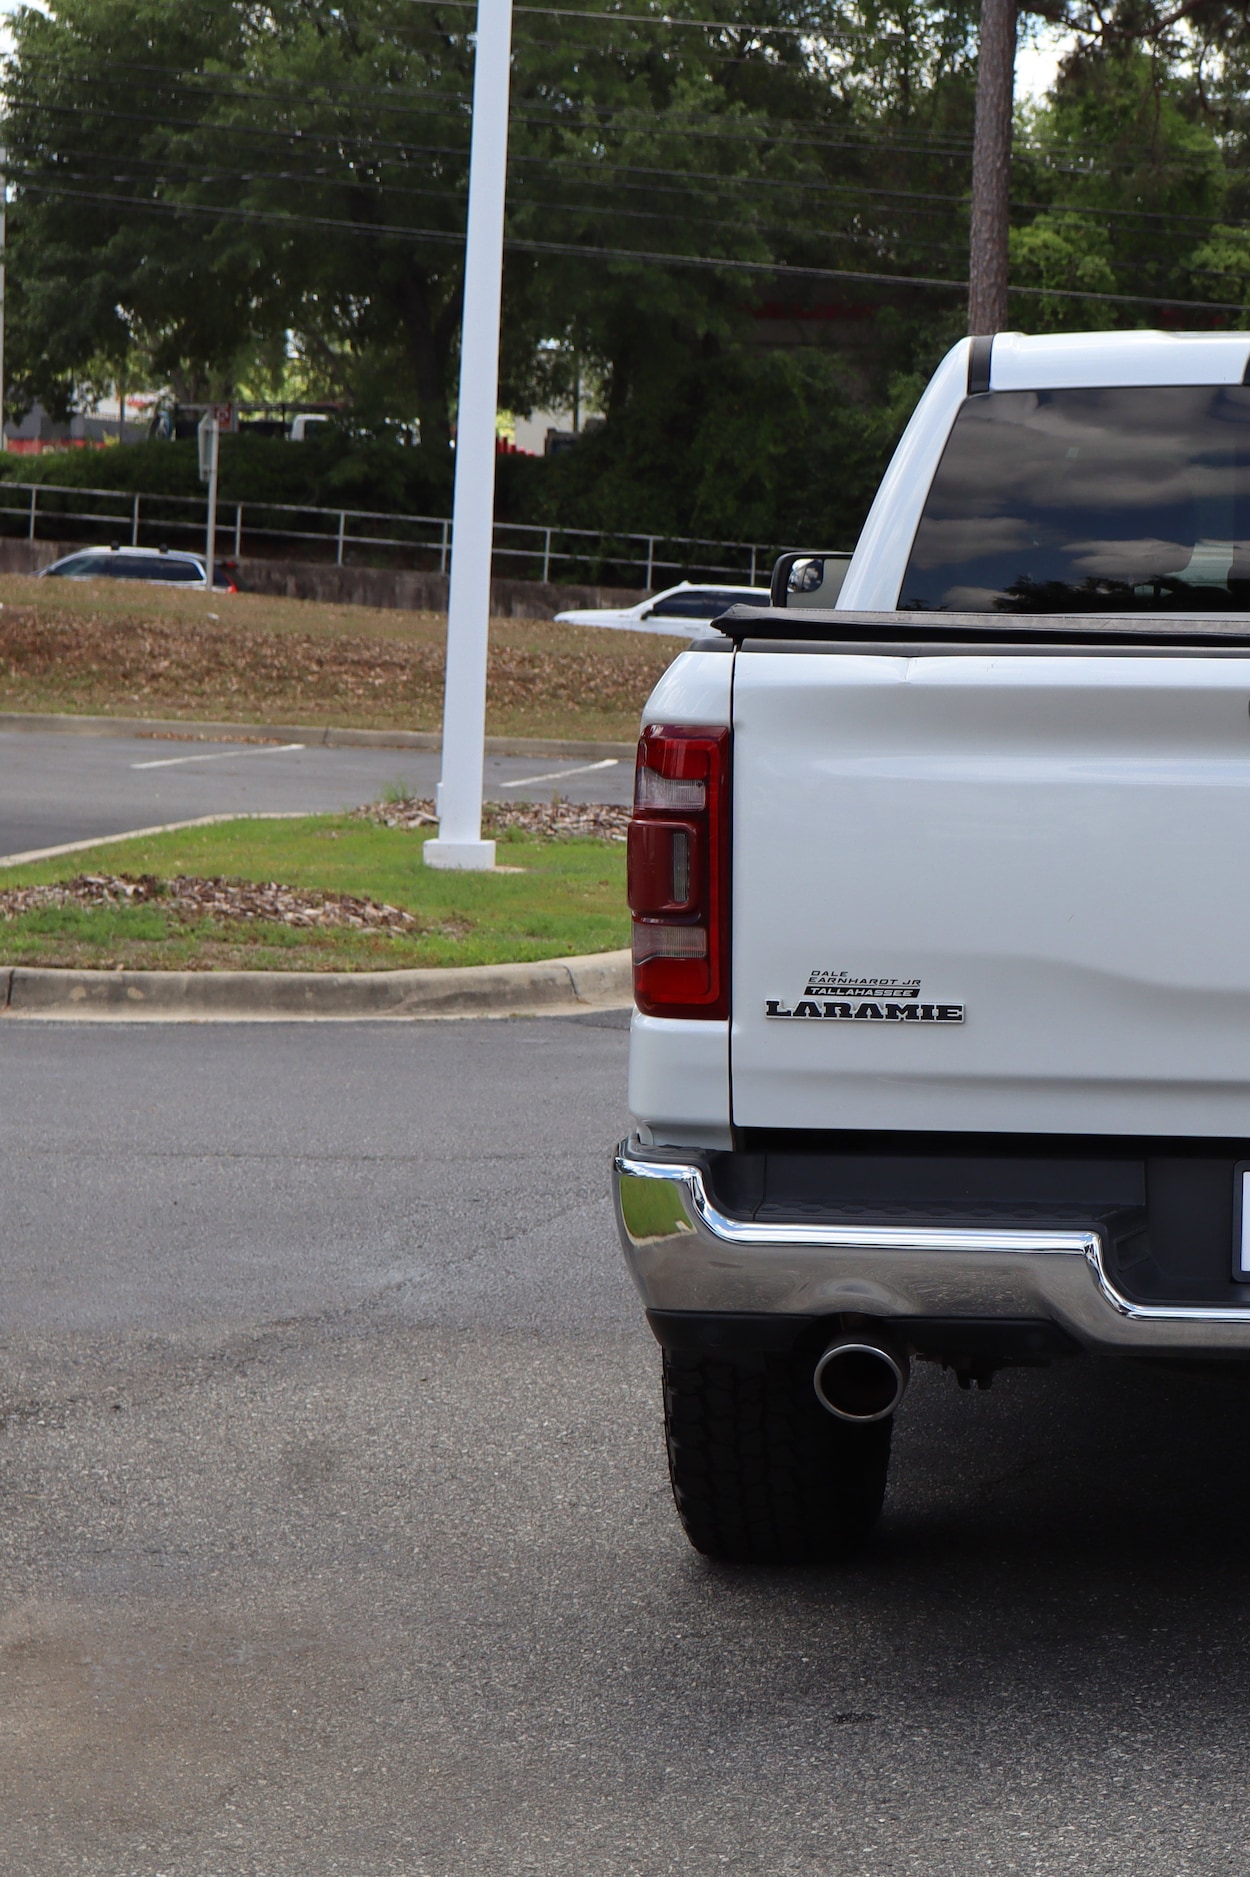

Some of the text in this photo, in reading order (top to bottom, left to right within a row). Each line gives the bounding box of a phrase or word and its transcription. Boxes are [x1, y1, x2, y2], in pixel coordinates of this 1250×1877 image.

[808, 977, 899, 986] EARNHARDT
[810, 987, 913, 997] TALLAHASSEE
[765, 1000, 966, 1022] LARAMIE
